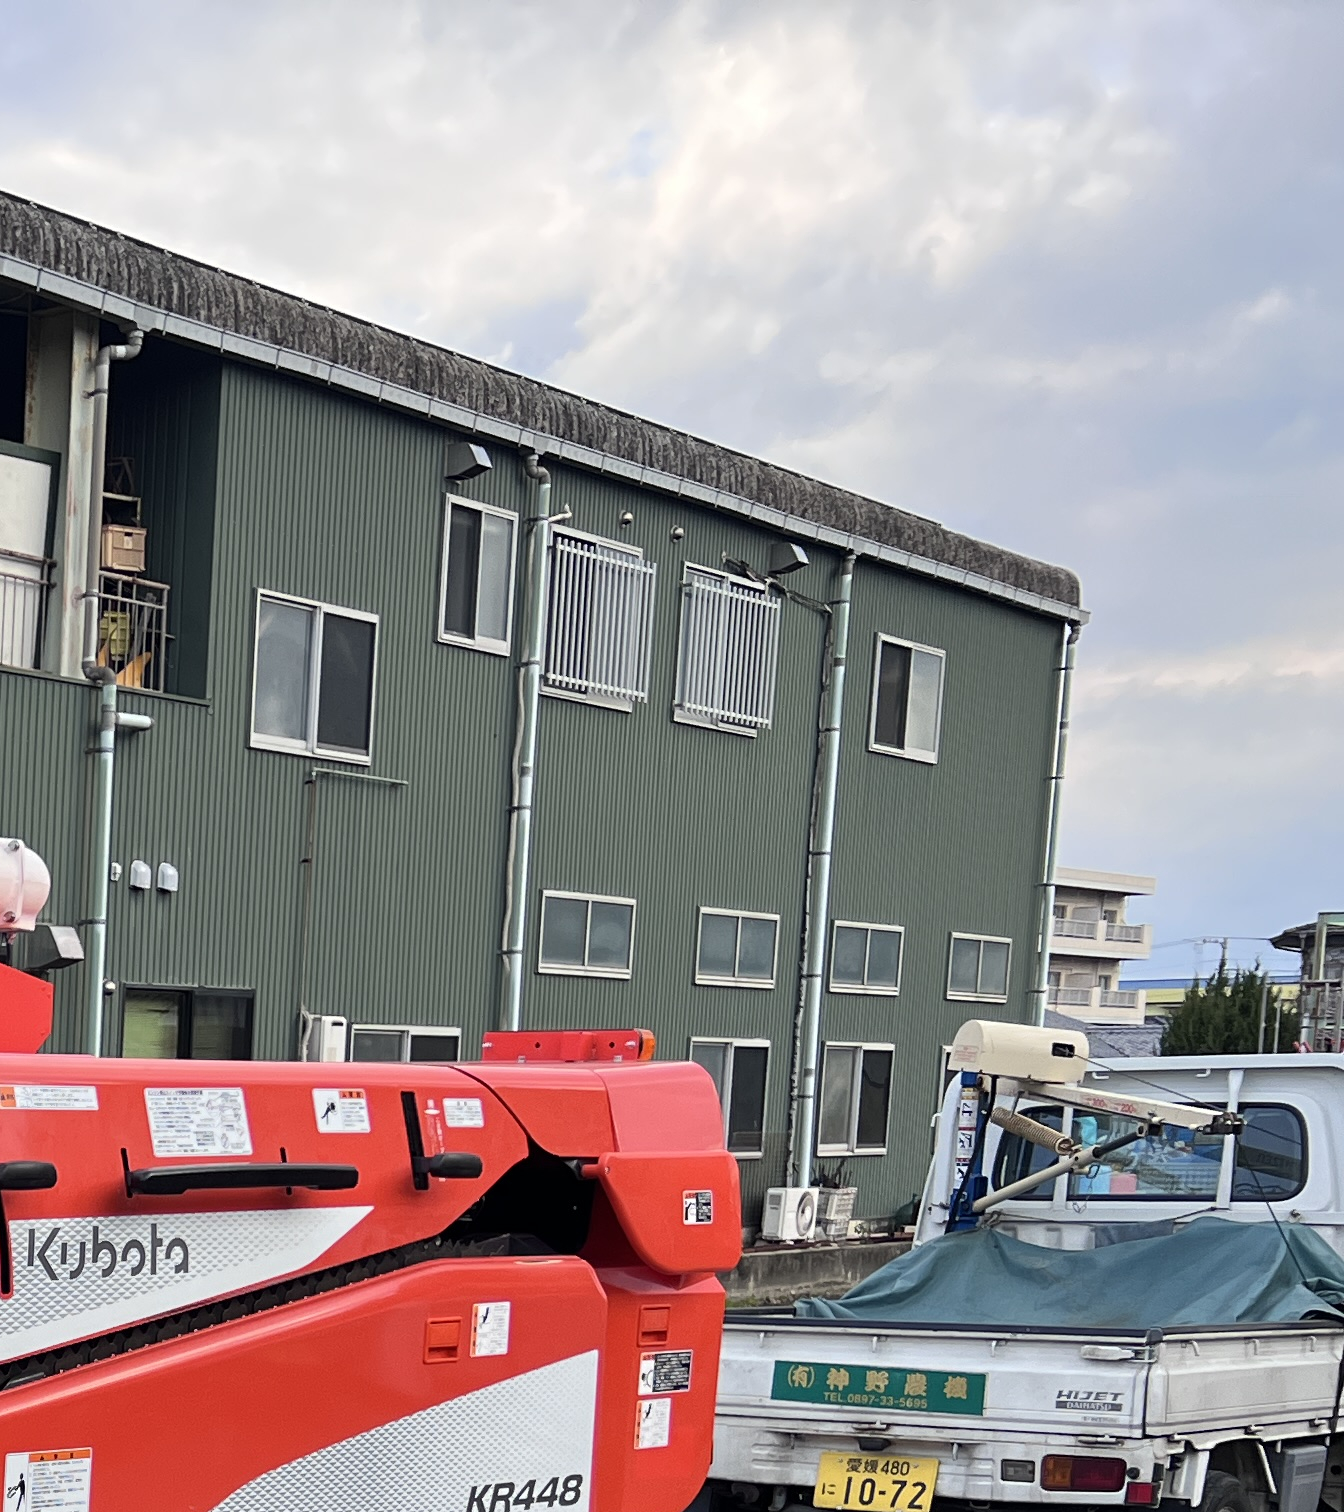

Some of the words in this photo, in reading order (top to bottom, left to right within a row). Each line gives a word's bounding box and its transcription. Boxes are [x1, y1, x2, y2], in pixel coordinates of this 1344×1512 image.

[27, 1223, 189, 1280] Kubota
[1056, 1390, 1125, 1401] HIJET
[1066, 1401, 1112, 1411] DAIHATSU
[846, 1458, 878, 1474] 愛媛
[880, 1460, 910, 1476] 480
[821, 1482, 836, 1495] に
[843, 1476, 927, 1510] 10-72
